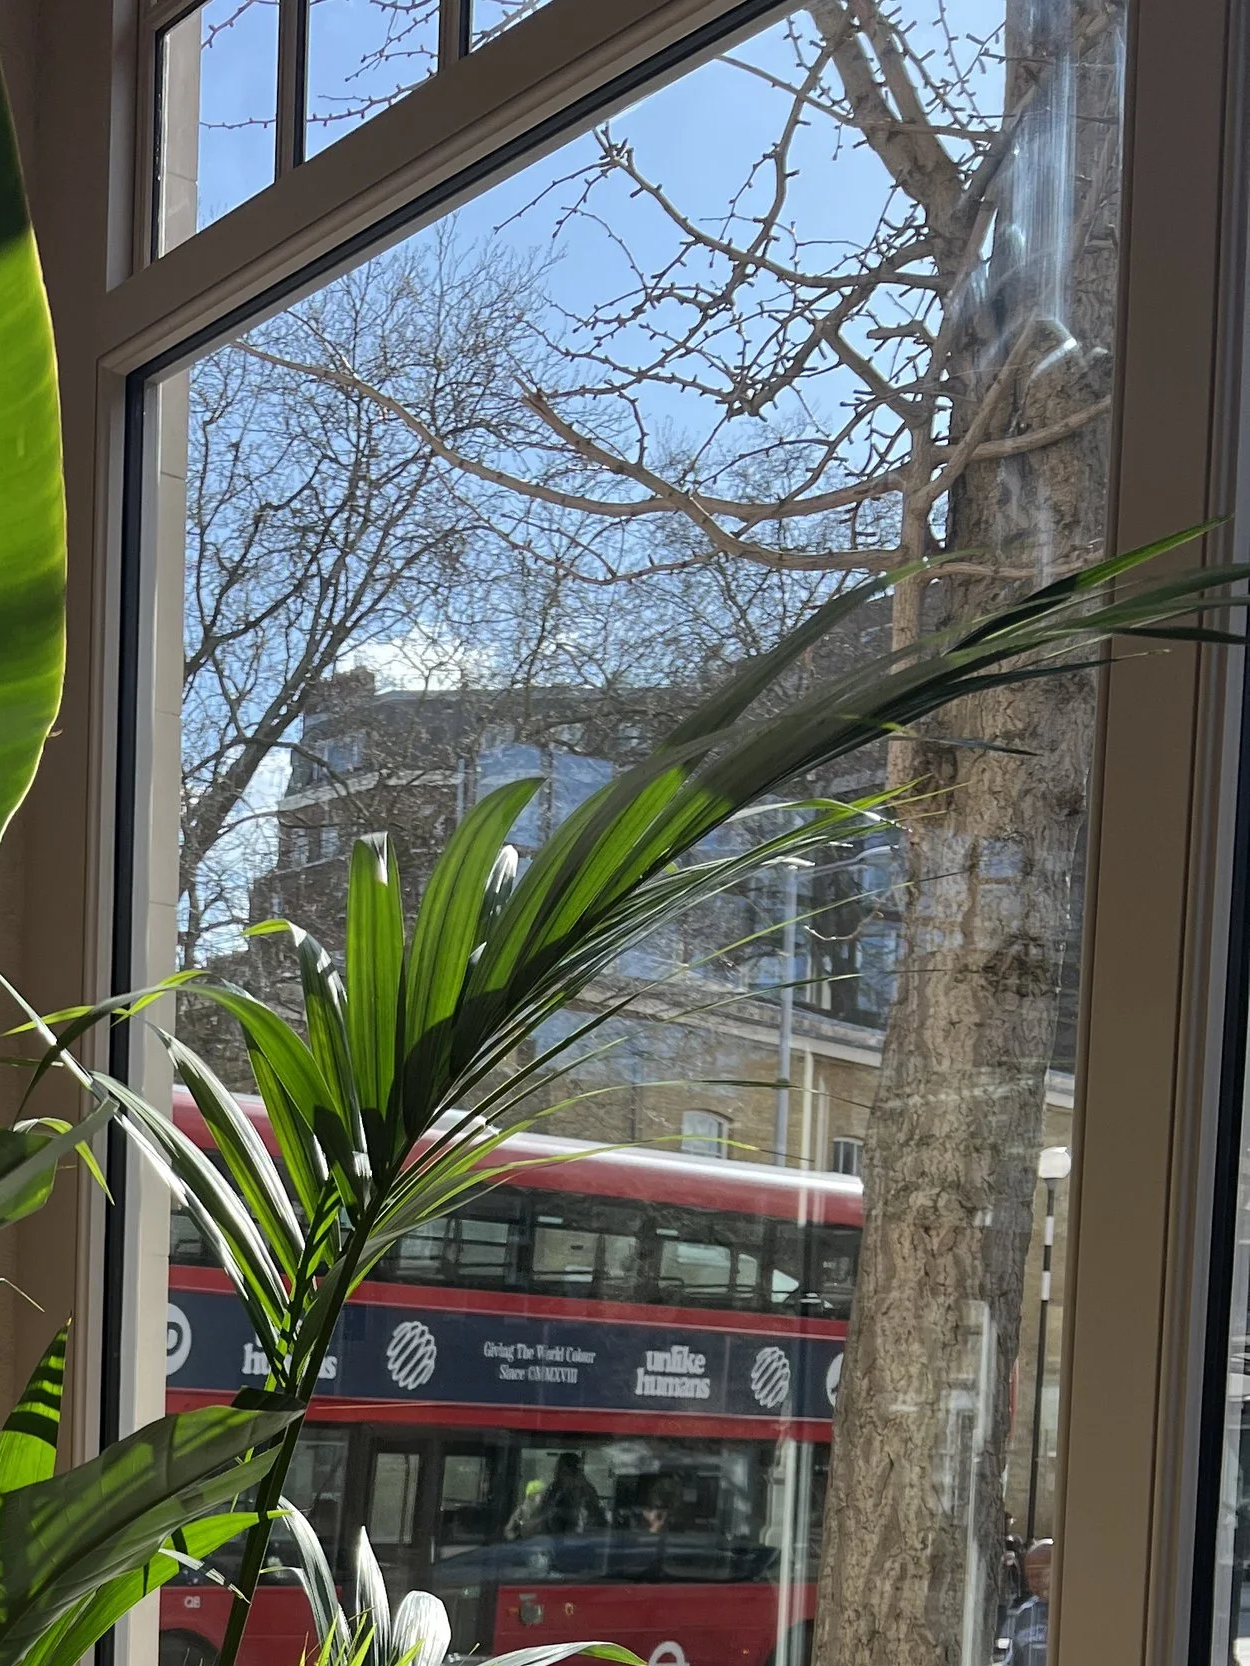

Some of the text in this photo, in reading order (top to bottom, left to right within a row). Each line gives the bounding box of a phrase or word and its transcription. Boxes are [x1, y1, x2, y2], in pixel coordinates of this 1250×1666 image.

[484, 1341, 596, 1363] Giving The World Colour
[646, 1345, 706, 1374] unlike
[499, 1365, 525, 1380] Since
[635, 1367, 710, 1399] humans
